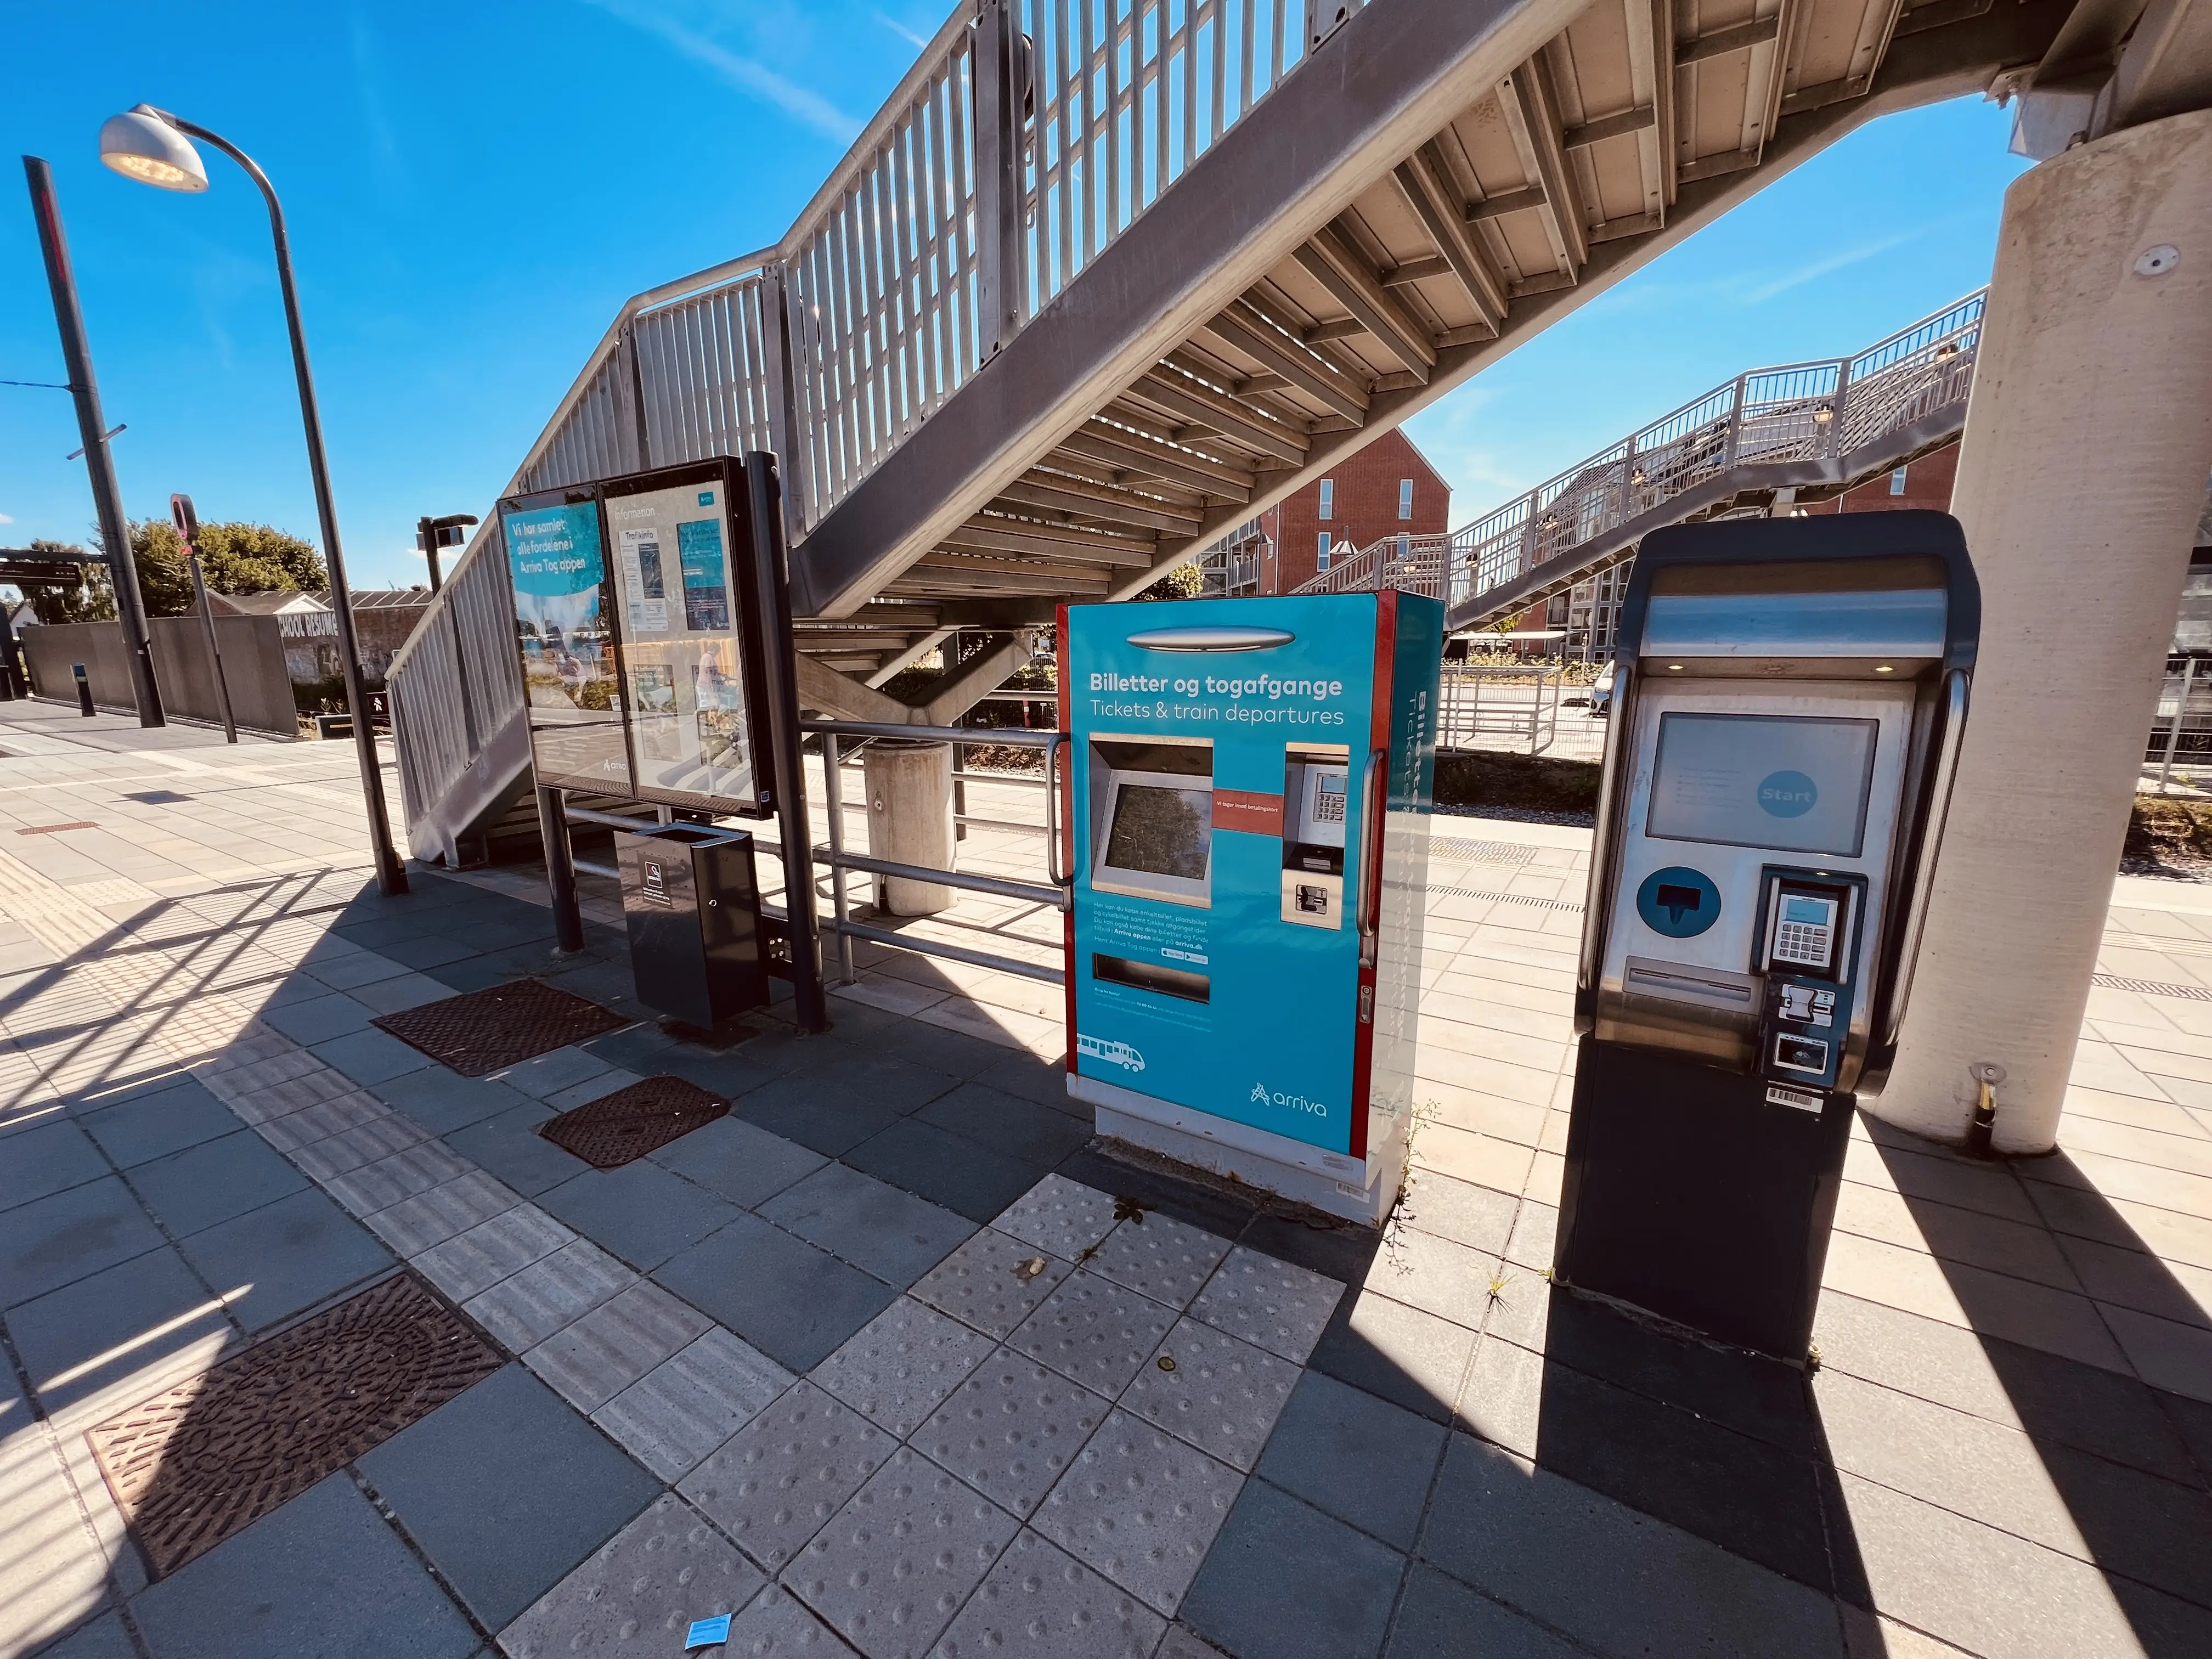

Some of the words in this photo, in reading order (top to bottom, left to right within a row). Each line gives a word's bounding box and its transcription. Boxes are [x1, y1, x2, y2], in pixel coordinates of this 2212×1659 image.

[614, 507, 655, 521] Information
[512, 522, 522, 536] Vi
[523, 522, 535, 535] har
[537, 517, 566, 533] samlet
[625, 531, 653, 540] Trafikinfo
[517, 541, 531, 555] alle
[531, 538, 568, 554] fordelene
[569, 535, 573, 549] i
[520, 559, 542, 573] Arriva
[543, 558, 558, 574] Tog
[560, 558, 585, 573] appen
[1090, 673, 1168, 692] Billetter
[1173, 680, 1199, 697] og
[1205, 674, 1342, 701] togafgange
[1090, 699, 1150, 718] Tickets
[1156, 701, 1168, 718] &
[1174, 702, 1218, 720] train
[1225, 703, 1344, 726] departures
[1403, 690, 1418, 796] Tickets
[1412, 691, 1426, 815] Billetter
[1761, 788, 1811, 803] Start
[1175, 917, 1207, 927] pladsbillet
[1109, 938, 1126, 947] Arriva
[1127, 941, 1138, 950] Tog
[1114, 928, 1132, 937] Arriva
[1133, 933, 1151, 941] appen
[1175, 940, 1203, 950] arriva.dk
[1158, 929, 1182, 938] billetter
[1193, 935, 1209, 943] finde
[1273, 1092, 1327, 1118] arriva
